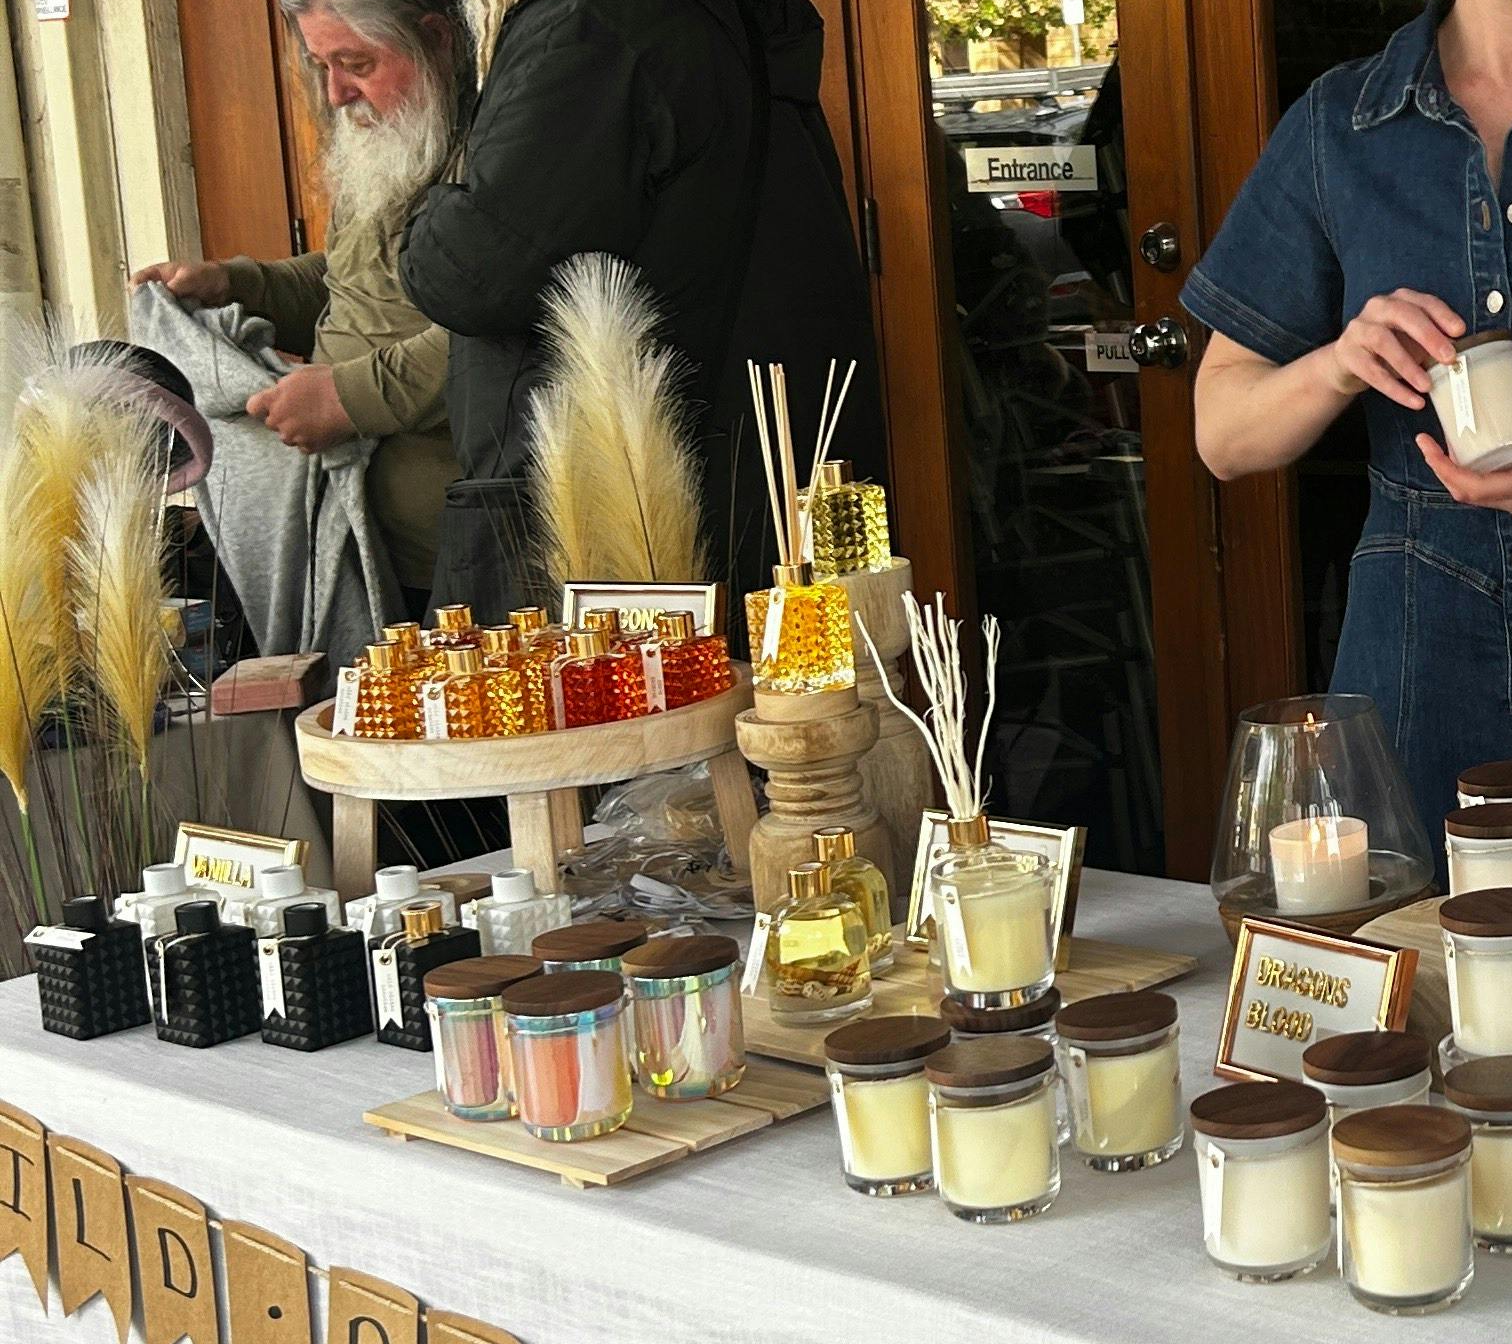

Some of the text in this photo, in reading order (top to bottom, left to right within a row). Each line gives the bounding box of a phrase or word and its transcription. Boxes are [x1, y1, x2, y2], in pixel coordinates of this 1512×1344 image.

[987, 157, 1074, 181] Entrance
[1097, 344, 1130, 360] PULL
[578, 606, 666, 631] GONS
[192, 854, 254, 889] VANILLA
[1256, 954, 1352, 1009] DRAGONS
[1245, 999, 1314, 1042] BLOOD
